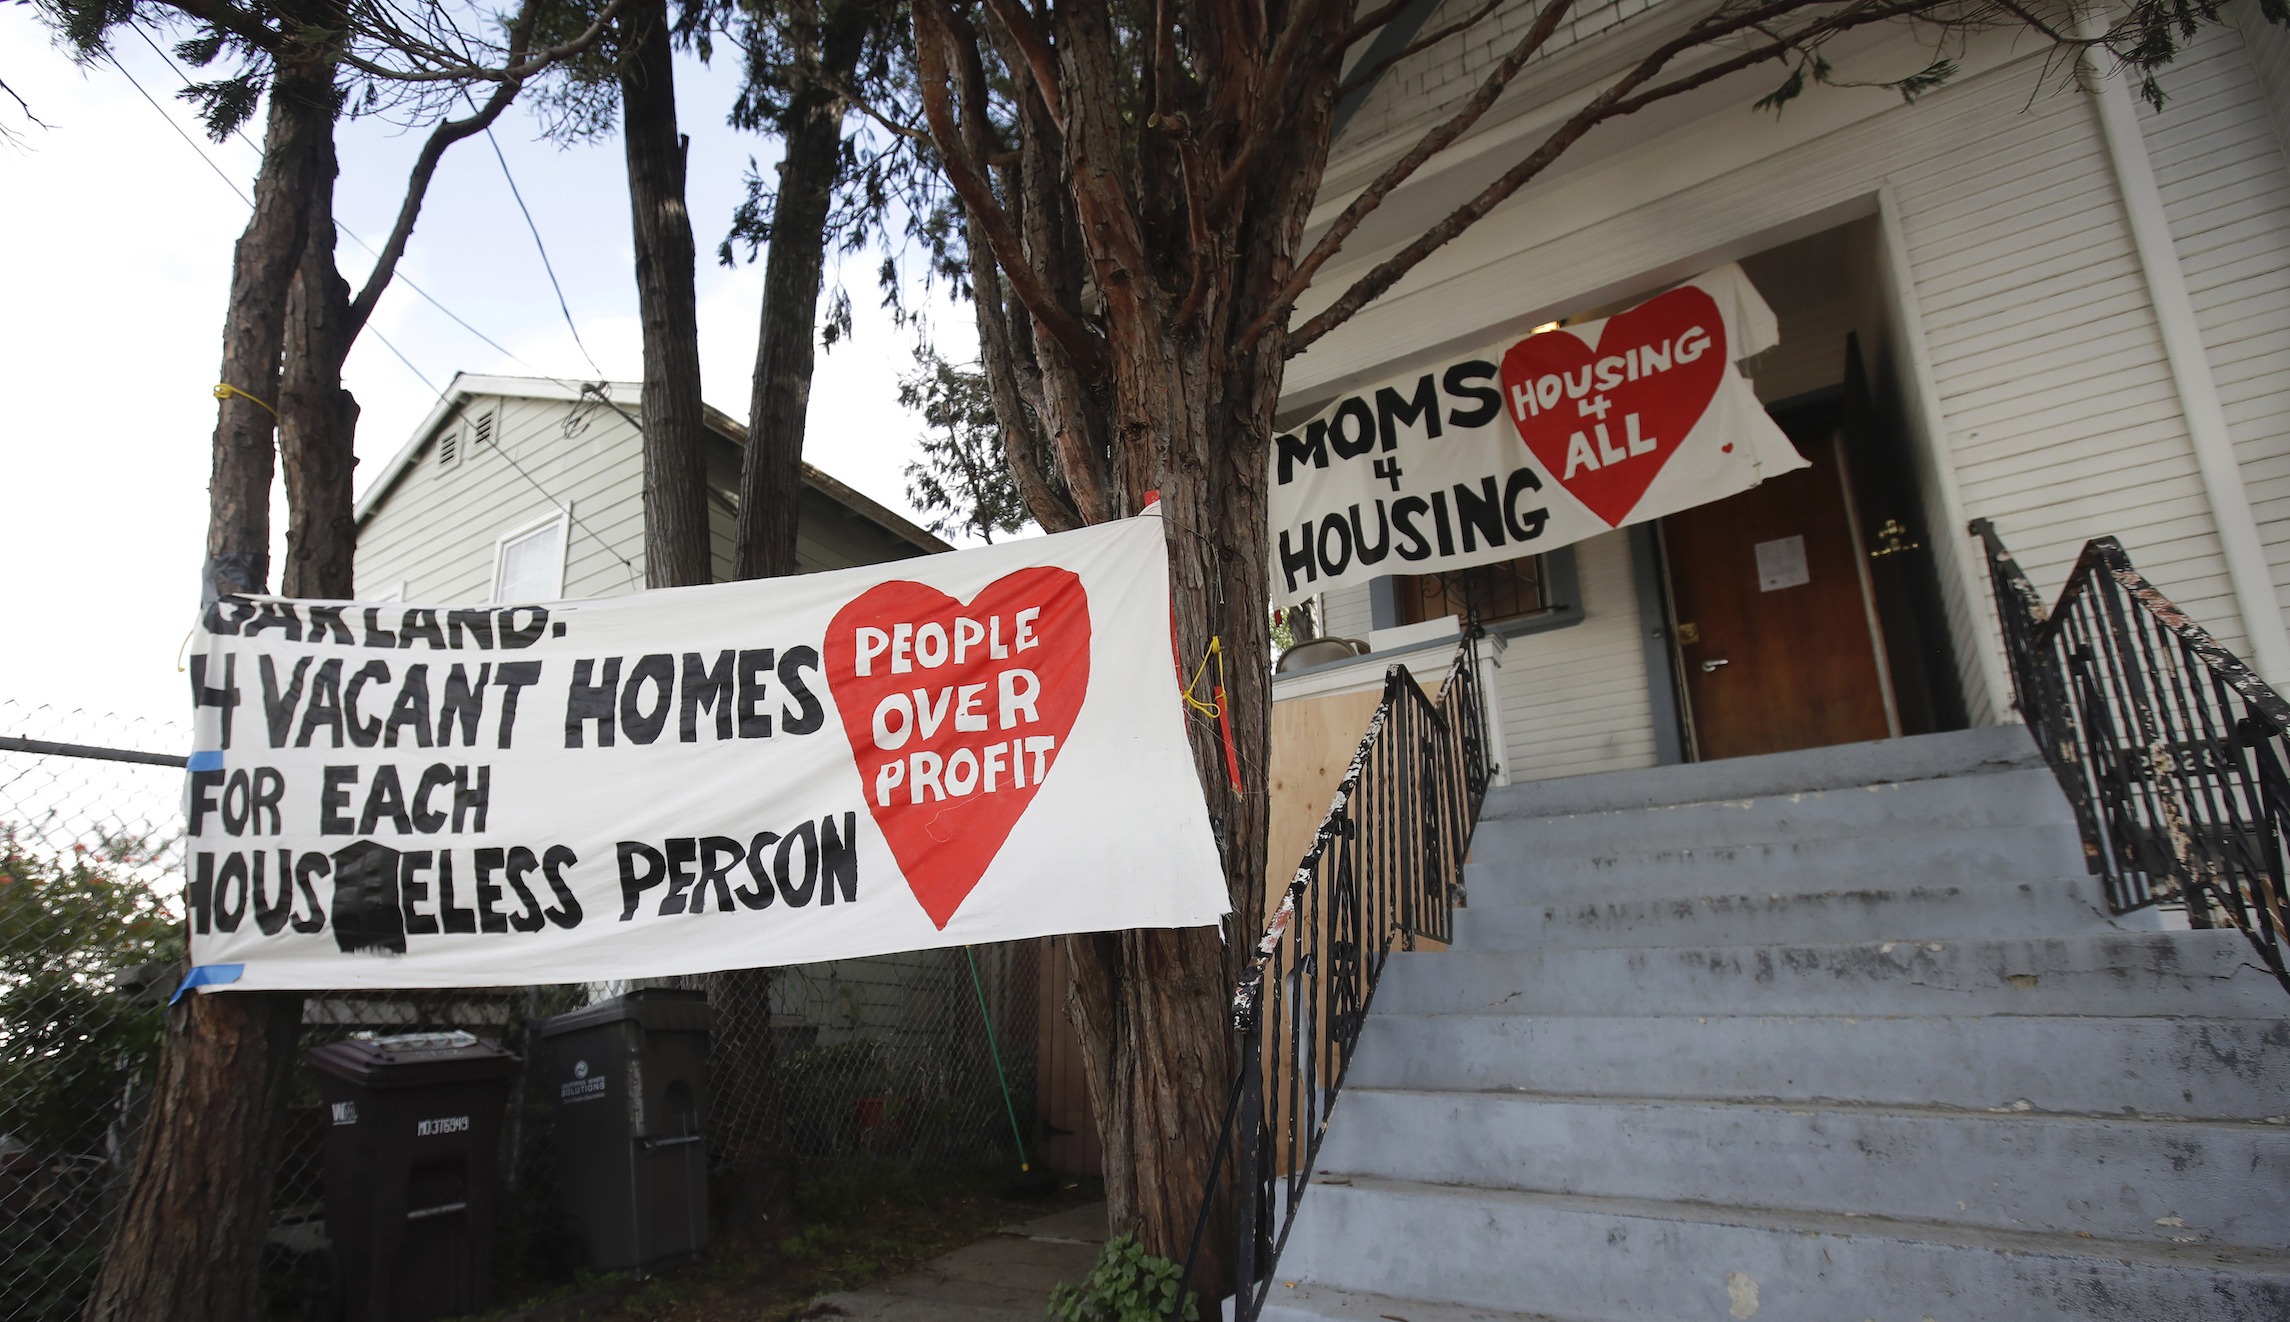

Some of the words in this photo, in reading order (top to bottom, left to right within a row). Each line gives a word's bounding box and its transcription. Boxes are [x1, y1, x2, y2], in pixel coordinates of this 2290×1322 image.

[1511, 325, 1711, 422] HOUSING
[1578, 394, 1612, 420] 4
[1275, 360, 1502, 485] MOMS
[1563, 412, 1658, 481] ALL
[1374, 456, 1403, 491] 4
[1279, 467, 1550, 594] HOUSING
[854, 606, 1041, 677] PEOPLE
[190, 653, 241, 750] 4
[258, 654, 543, 749] VACANT
[564, 645, 825, 749] HOMES
[872, 668, 1042, 751] OVER
[189, 766, 285, 837] FOR
[320, 763, 491, 836] EACH
[876, 735, 1056, 807] PROFIT
[616, 811, 858, 922] PERSON
